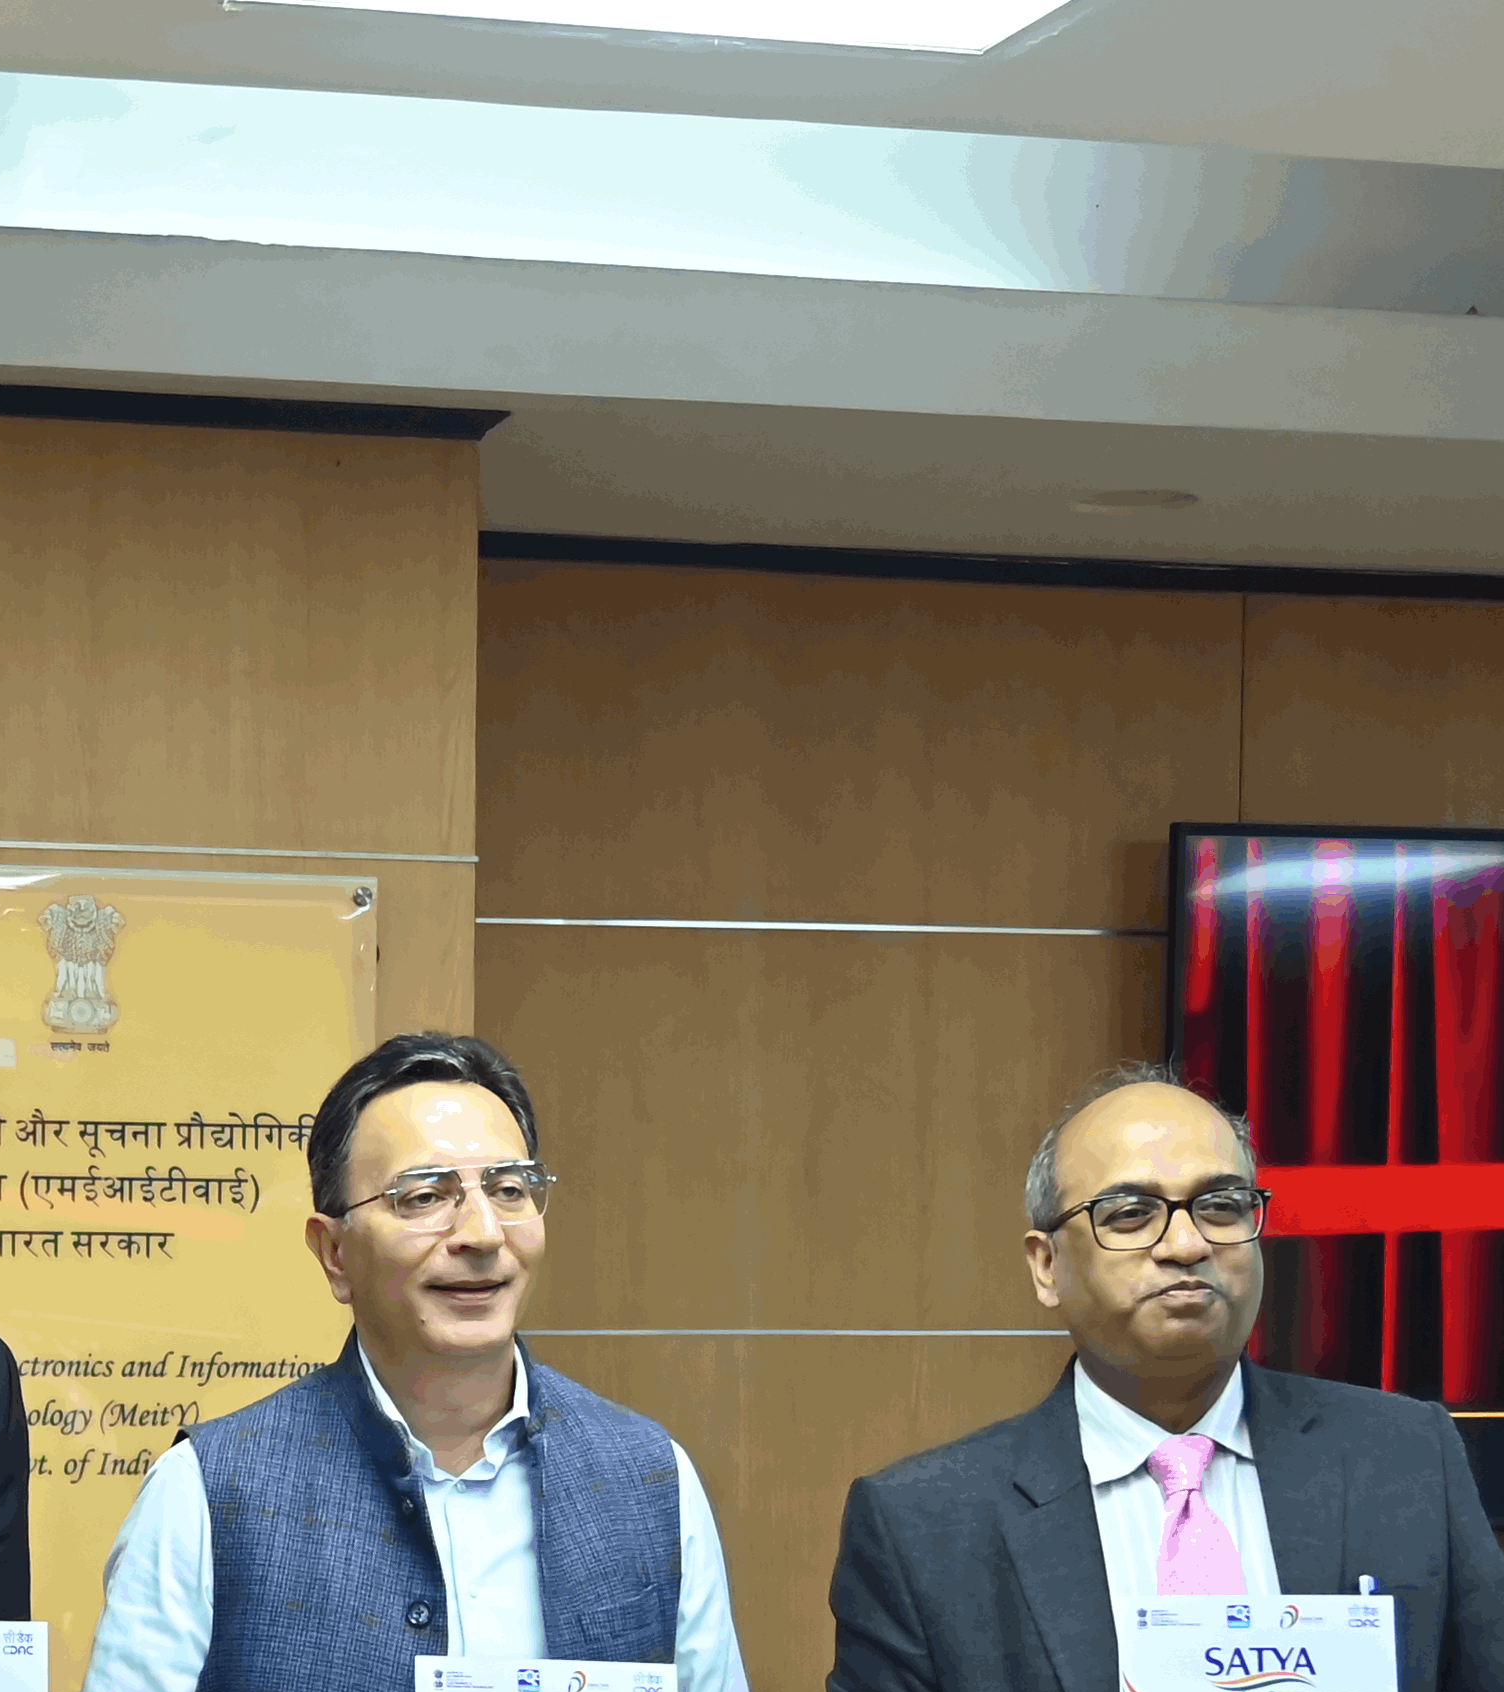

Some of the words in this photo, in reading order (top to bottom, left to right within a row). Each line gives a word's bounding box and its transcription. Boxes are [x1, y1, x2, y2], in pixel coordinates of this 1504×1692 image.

[16, 1109, 68, 1148] और
[78, 1115, 163, 1158] सूचना
[20, 1165, 261, 1214] (एमईआईटीवाई)
[70, 1232, 174, 1259] सरकार
[19, 1352, 113, 1377] ctronics
[120, 1352, 168, 1378] and
[27, 1399, 92, 1435] ology
[100, 1400, 199, 1429] (MeitY)
[63, 1451, 90, 1483] of
[96, 1450, 158, 1476] Indi
[1204, 1647, 1316, 1676] SATYA
